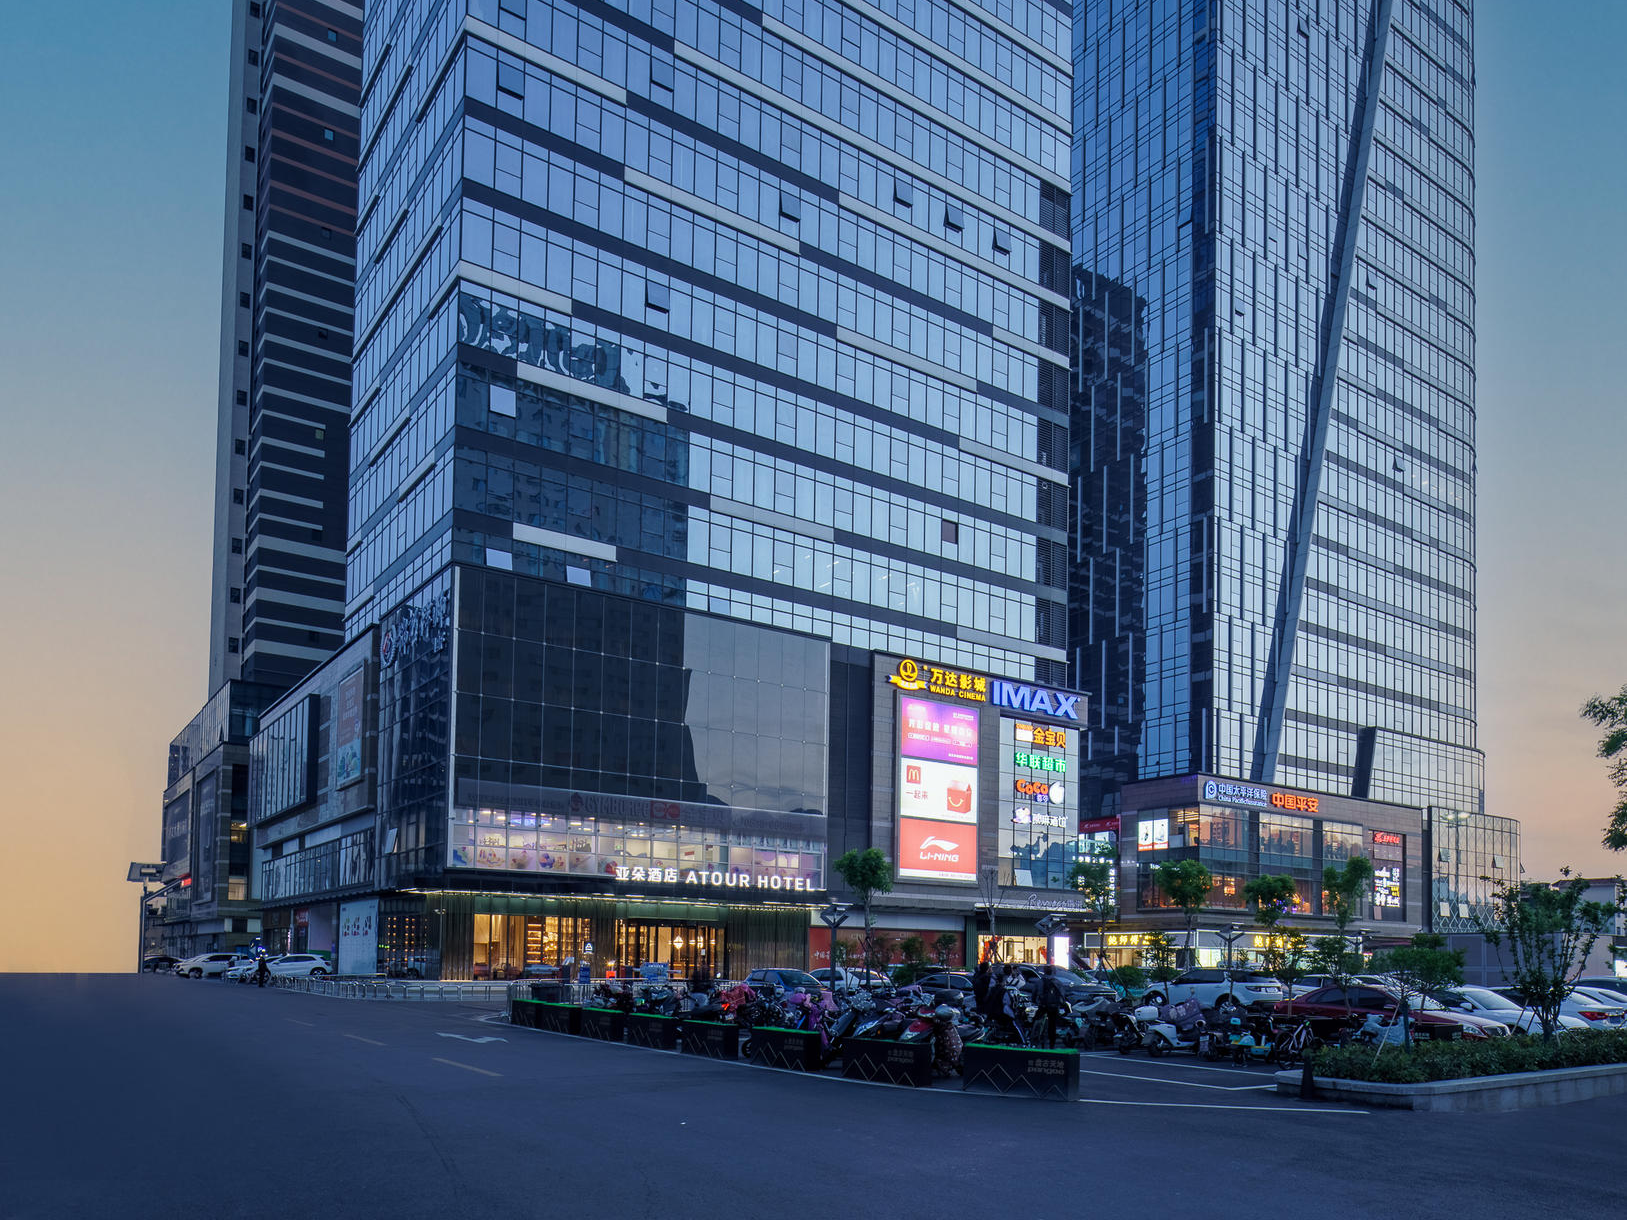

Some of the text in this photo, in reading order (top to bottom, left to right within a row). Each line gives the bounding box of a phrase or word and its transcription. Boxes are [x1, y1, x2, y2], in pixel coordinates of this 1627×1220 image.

[930, 668, 986, 692] 万达影城
[929, 685, 955, 696] WANDA
[958, 690, 986, 702] CINEMA
[992, 681, 1079, 720] IMAX
[1033, 727, 1066, 748] 金宝贝
[1015, 752, 1066, 773] 华联超市
[1218, 783, 1267, 800] 中国太平洋保险
[1272, 792, 1319, 813] 中国平安
[919, 852, 959, 862] LI-NING
[615, 866, 678, 883] 亚朵酒店
[685, 870, 815, 892] ATOUR HOTEL
